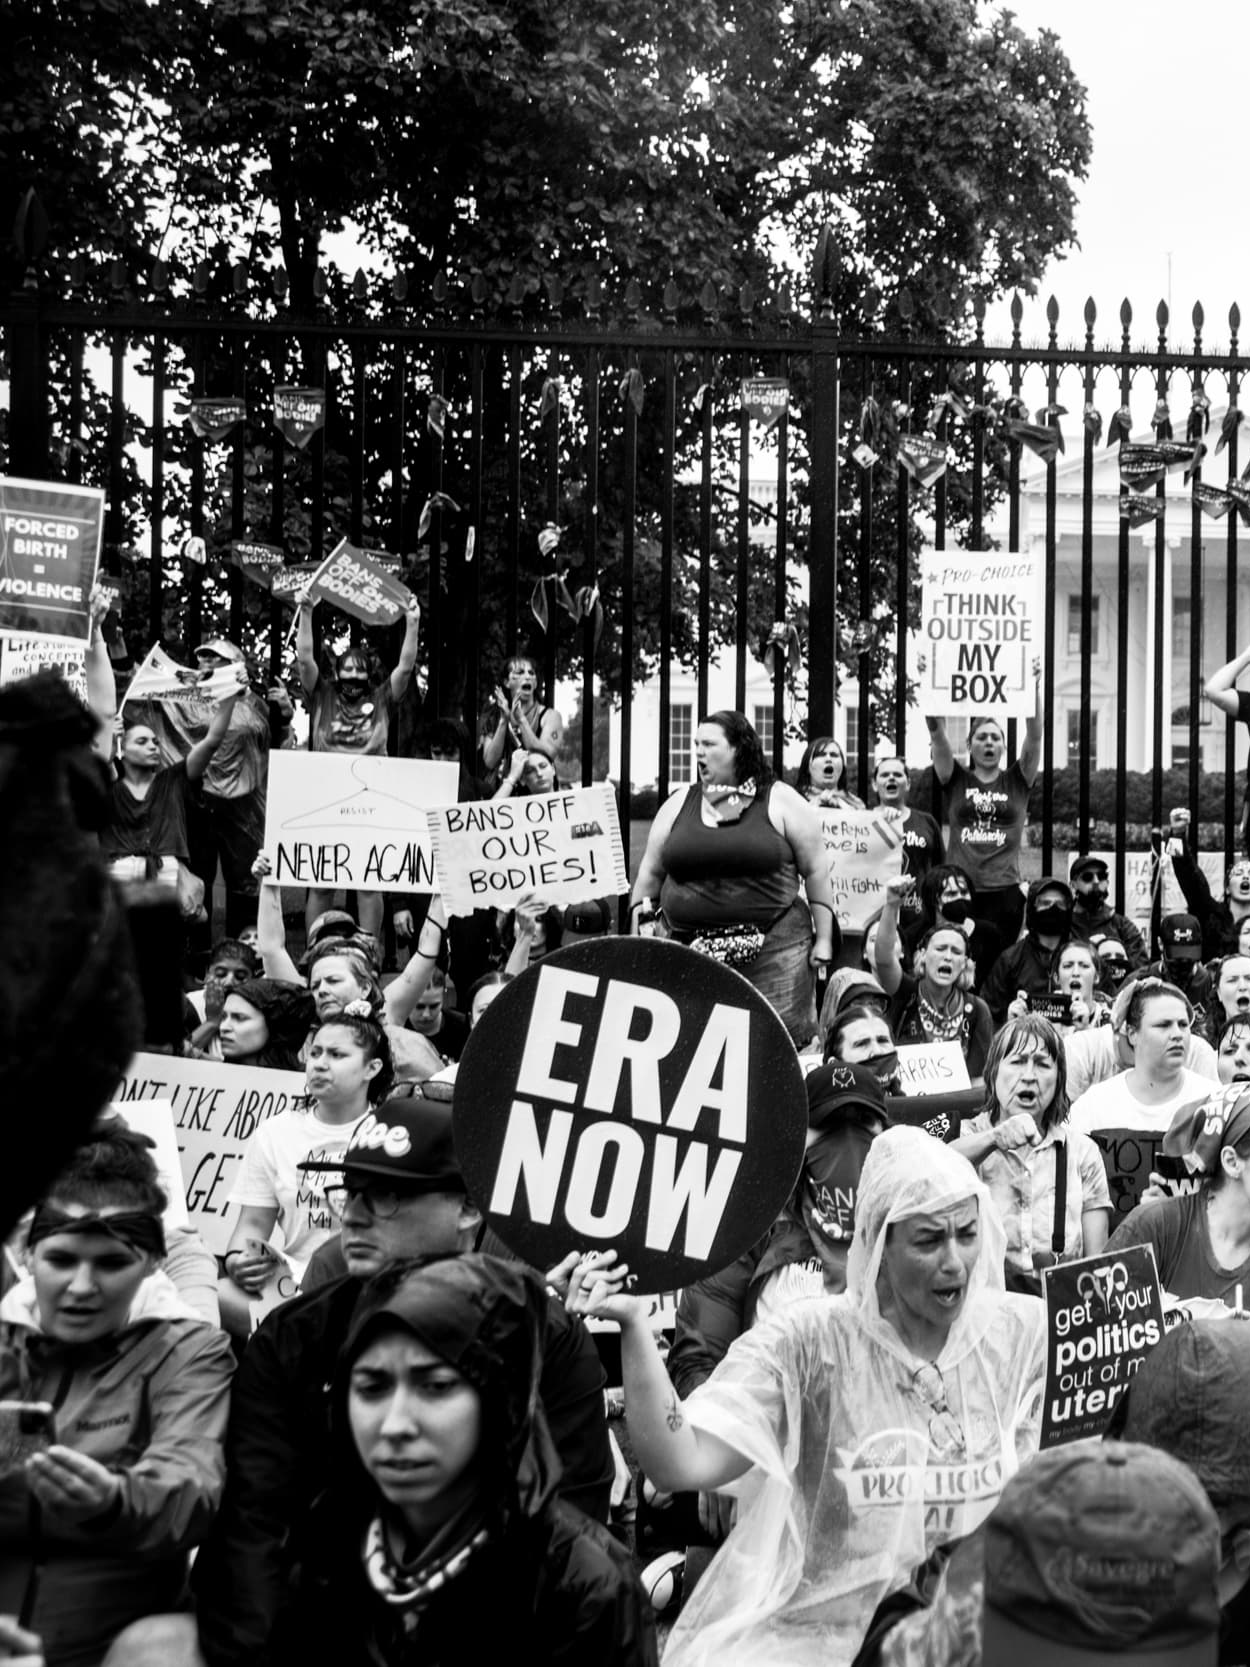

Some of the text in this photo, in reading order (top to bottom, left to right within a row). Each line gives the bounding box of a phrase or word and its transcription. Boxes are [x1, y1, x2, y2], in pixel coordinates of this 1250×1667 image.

[4, 516, 80, 541] FORCED
[13, 537, 68, 561] BIRTH
[337, 553, 384, 589] BANS
[942, 564, 1034, 586] PRO-CHOICE
[317, 573, 381, 614] BODIES
[328, 564, 364, 586] OFF
[362, 585, 400, 615] OUR
[943, 593, 1017, 617] THINK
[927, 617, 1033, 642] OUTSIDE
[957, 643, 1002, 672] MY
[950, 674, 1009, 704] BOX
[445, 795, 577, 834] BANS OFF
[481, 829, 557, 861] OUR
[907, 830, 927, 849] the
[961, 826, 1007, 847] Patriarchy
[276, 842, 435, 887] NEVER AGAIN
[469, 850, 598, 894] BODIES!
[851, 877, 884, 895] fight
[515, 964, 752, 1145] ERA
[488, 1099, 744, 1262] NOW
[308, 1211, 332, 1230] My
[1055, 1285, 1153, 1337] get your
[1055, 1319, 1161, 1377] politics
[1059, 1356, 1147, 1392] out of m
[1050, 1382, 1130, 1423] uter
